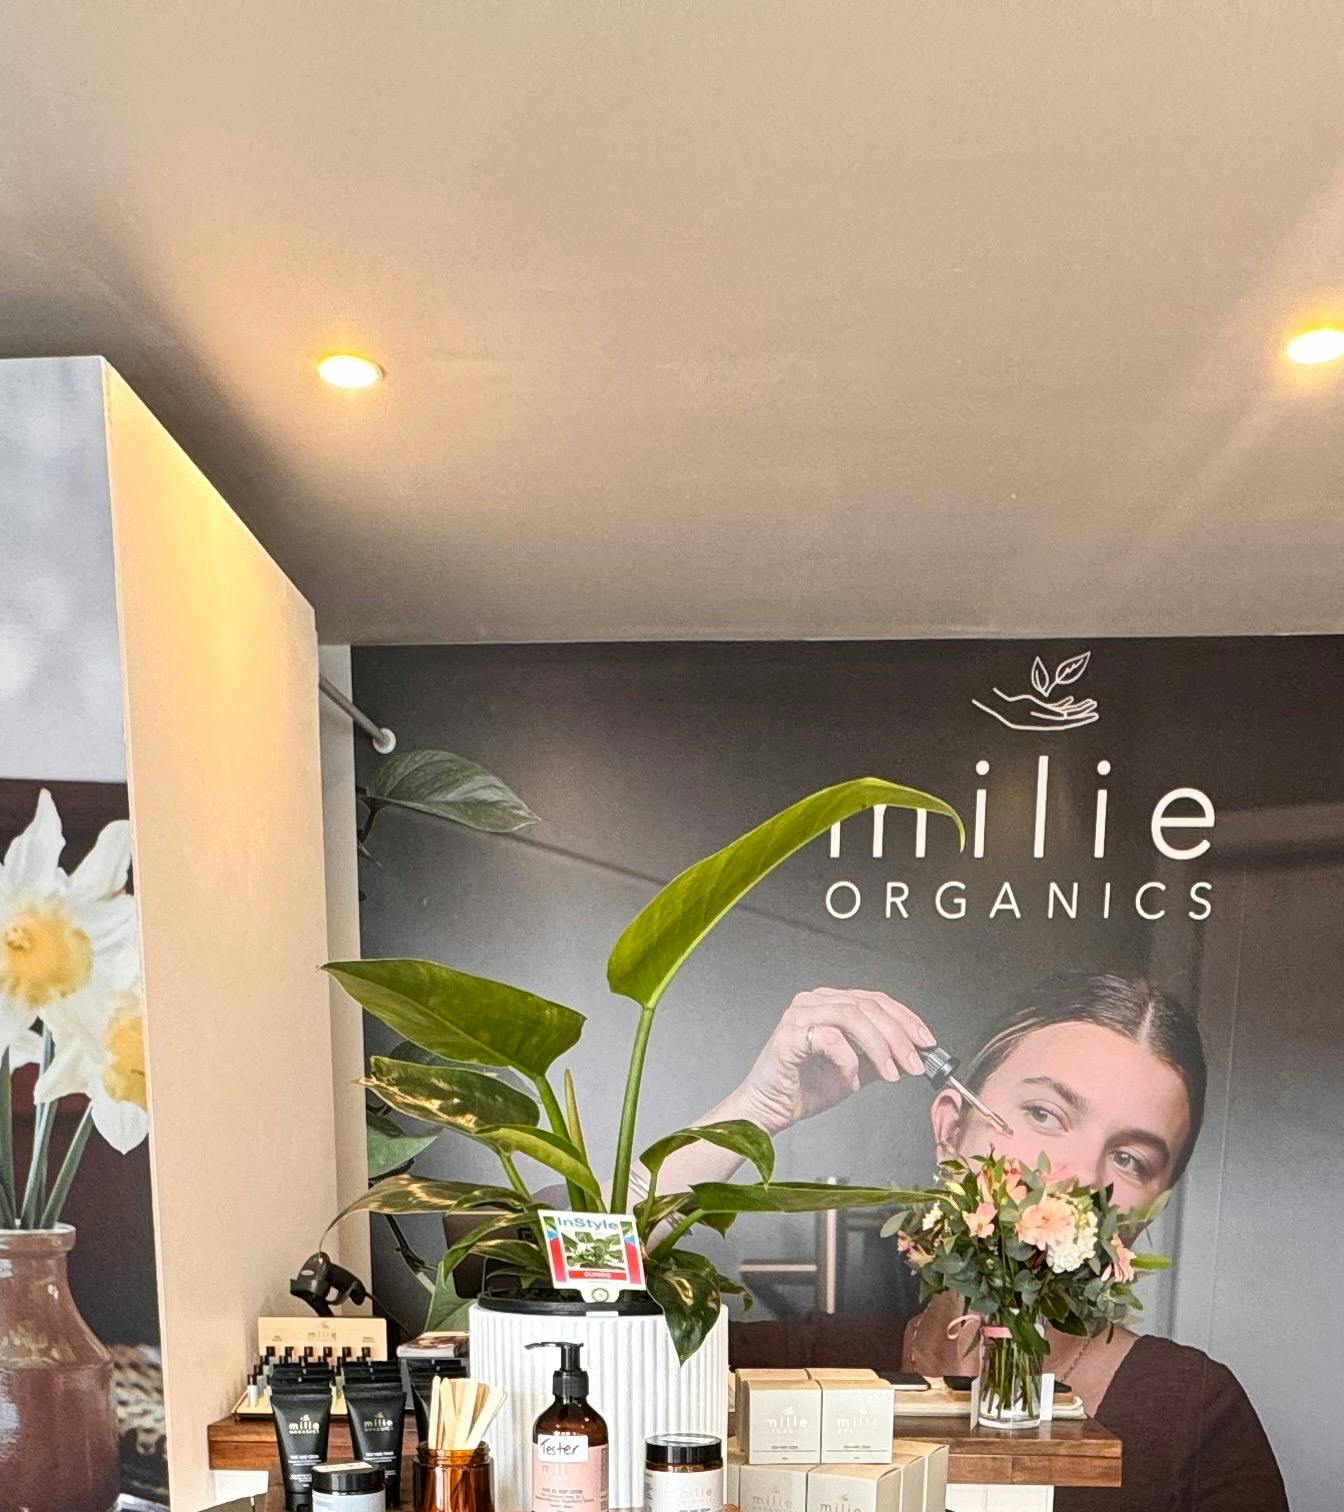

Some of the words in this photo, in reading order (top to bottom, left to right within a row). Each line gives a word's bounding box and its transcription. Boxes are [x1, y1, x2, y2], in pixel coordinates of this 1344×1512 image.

[824, 880, 1214, 922] ORGANICS
[557, 1216, 619, 1231] InStyle
[540, 1437, 580, 1456] Tester
